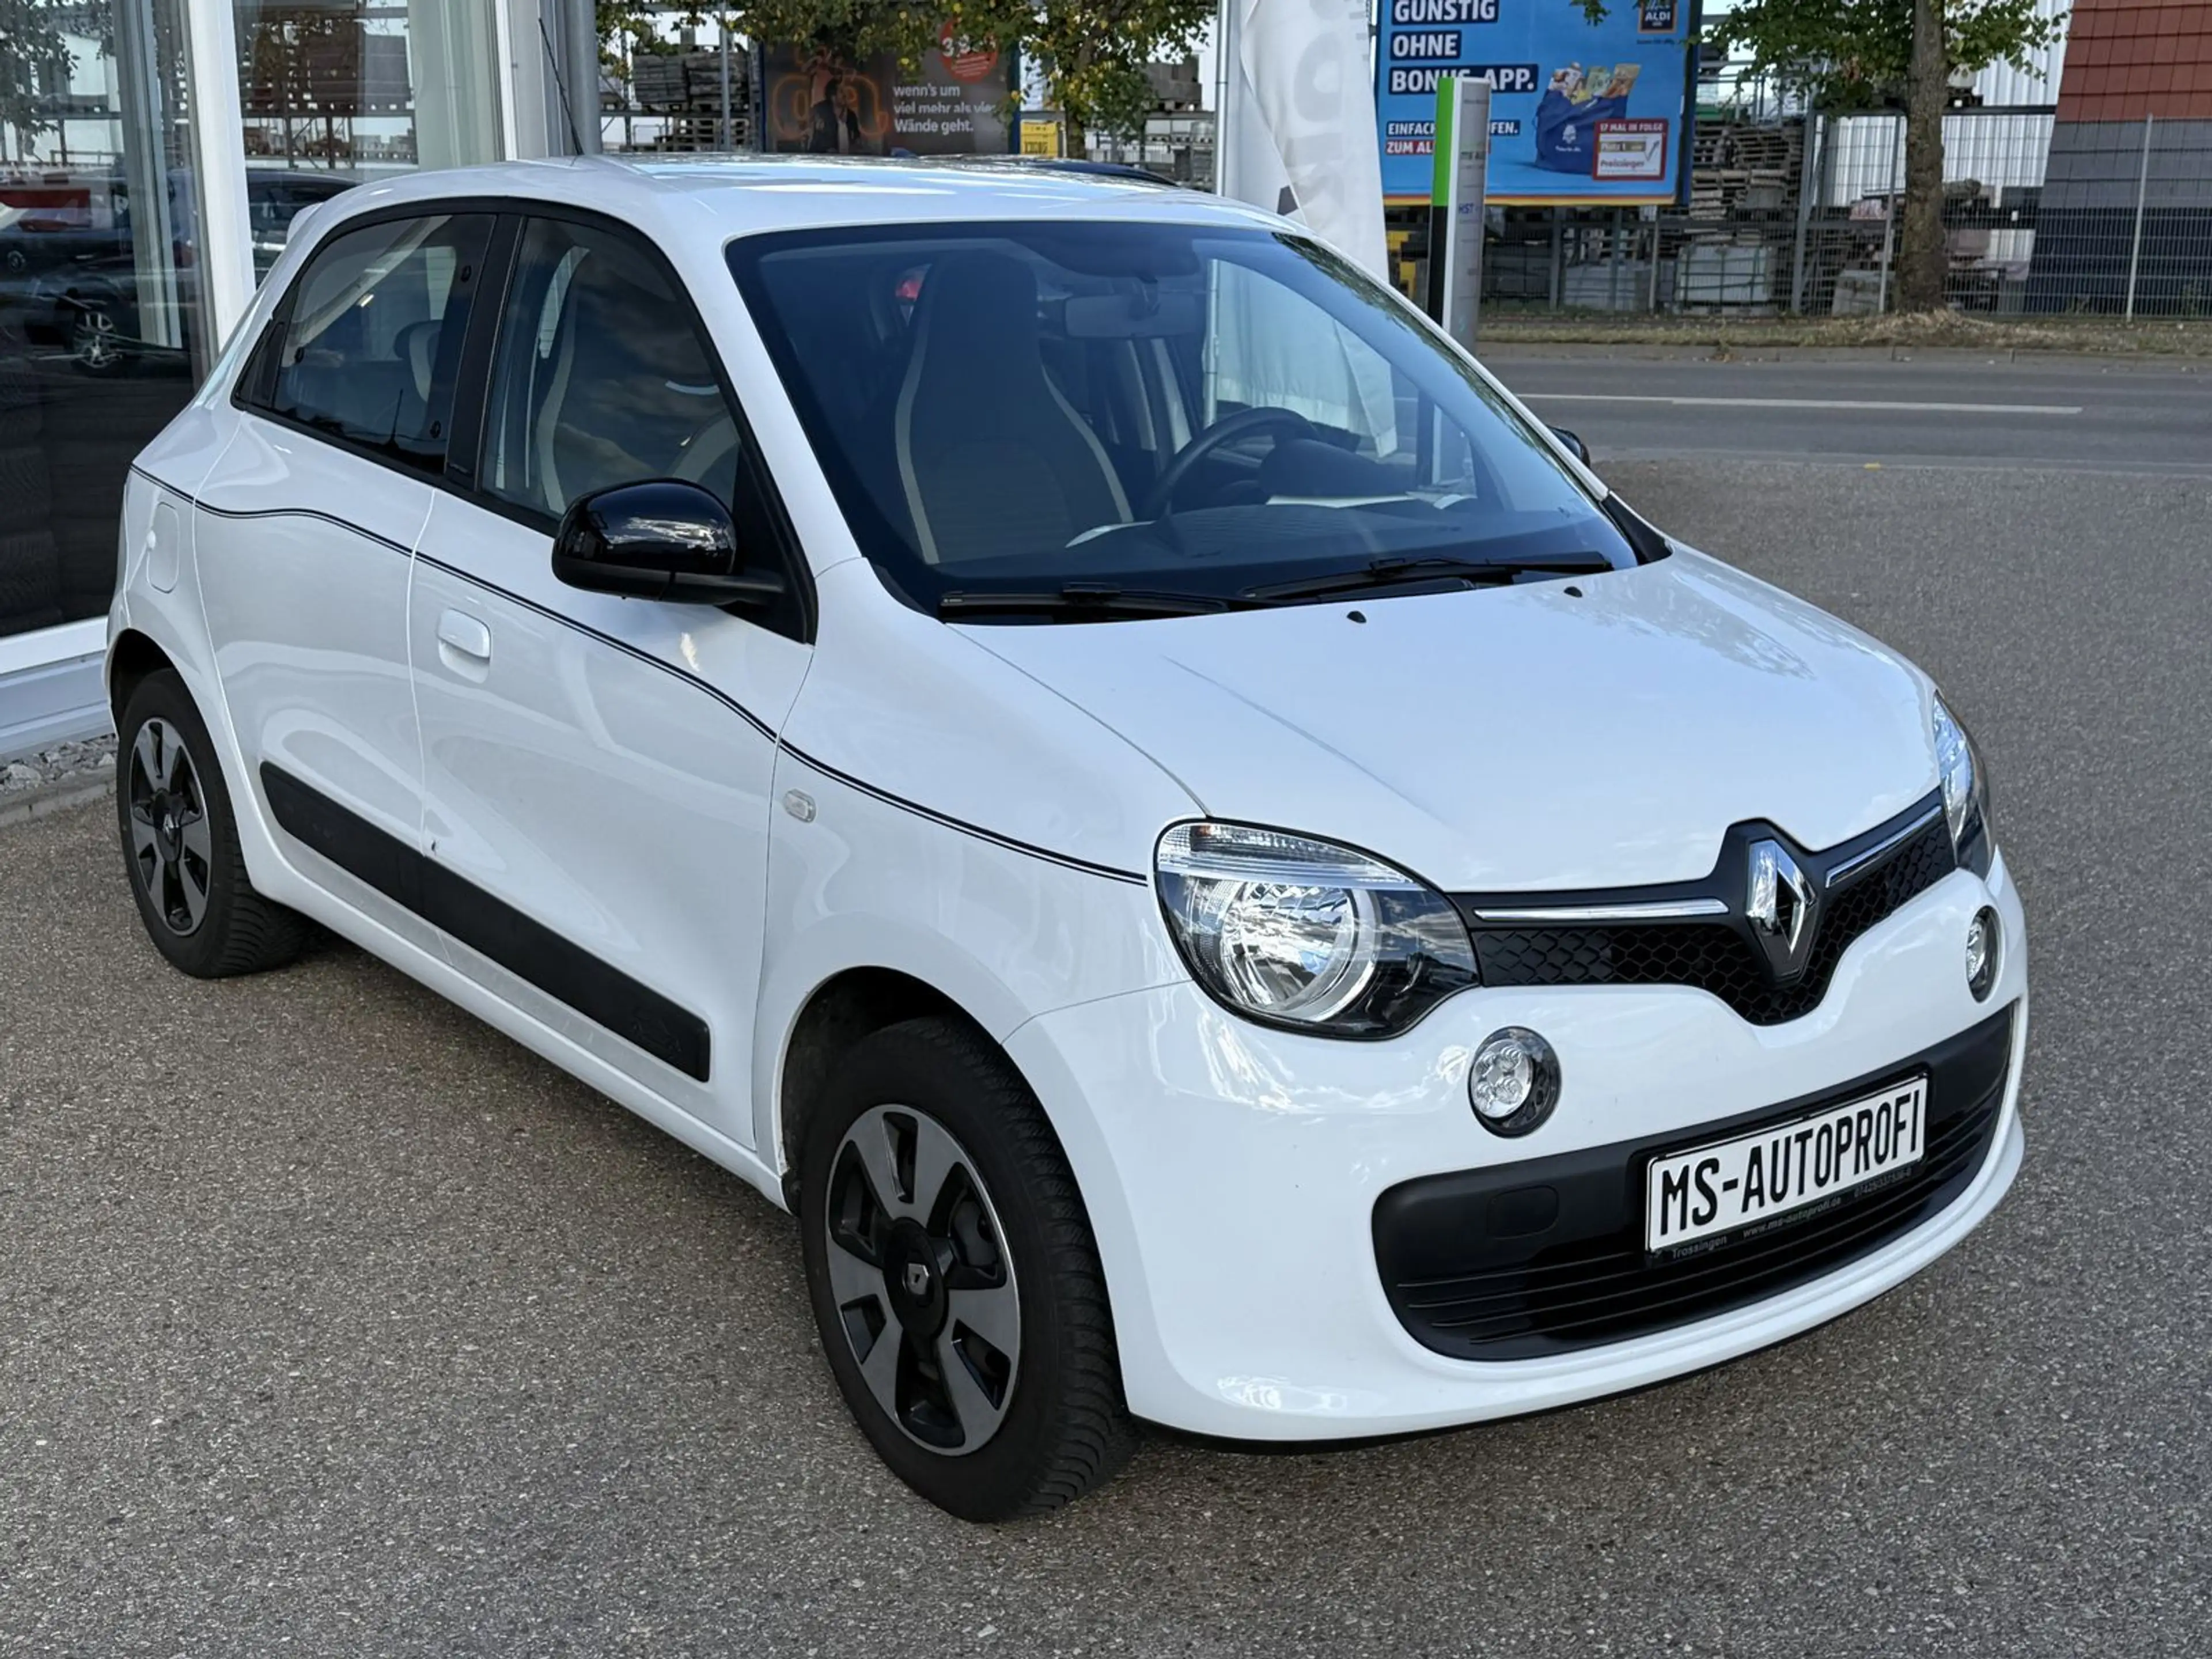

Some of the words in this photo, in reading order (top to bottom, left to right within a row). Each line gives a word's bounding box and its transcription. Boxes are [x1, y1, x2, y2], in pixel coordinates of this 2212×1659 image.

[1645, 12, 1671, 21] ALDI
[1393, 34, 1458, 57] OHNE
[894, 84, 937, 97] wenn's
[940, 86, 960, 97] um
[894, 102, 915, 113] viel
[918, 102, 951, 113] mehr
[954, 102, 972, 113] als
[895, 118, 938, 132] Wände
[941, 120, 974, 136] geht.
[1639, 123, 1663, 131] FOLGE
[1387, 141, 1413, 153] ZUM
[1661, 1089, 1919, 1236] MS-AUTOPROFI
[1672, 1236, 1727, 1259] Trossingen
[1743, 1196, 1842, 1238] www.ms-autoprofi.de
